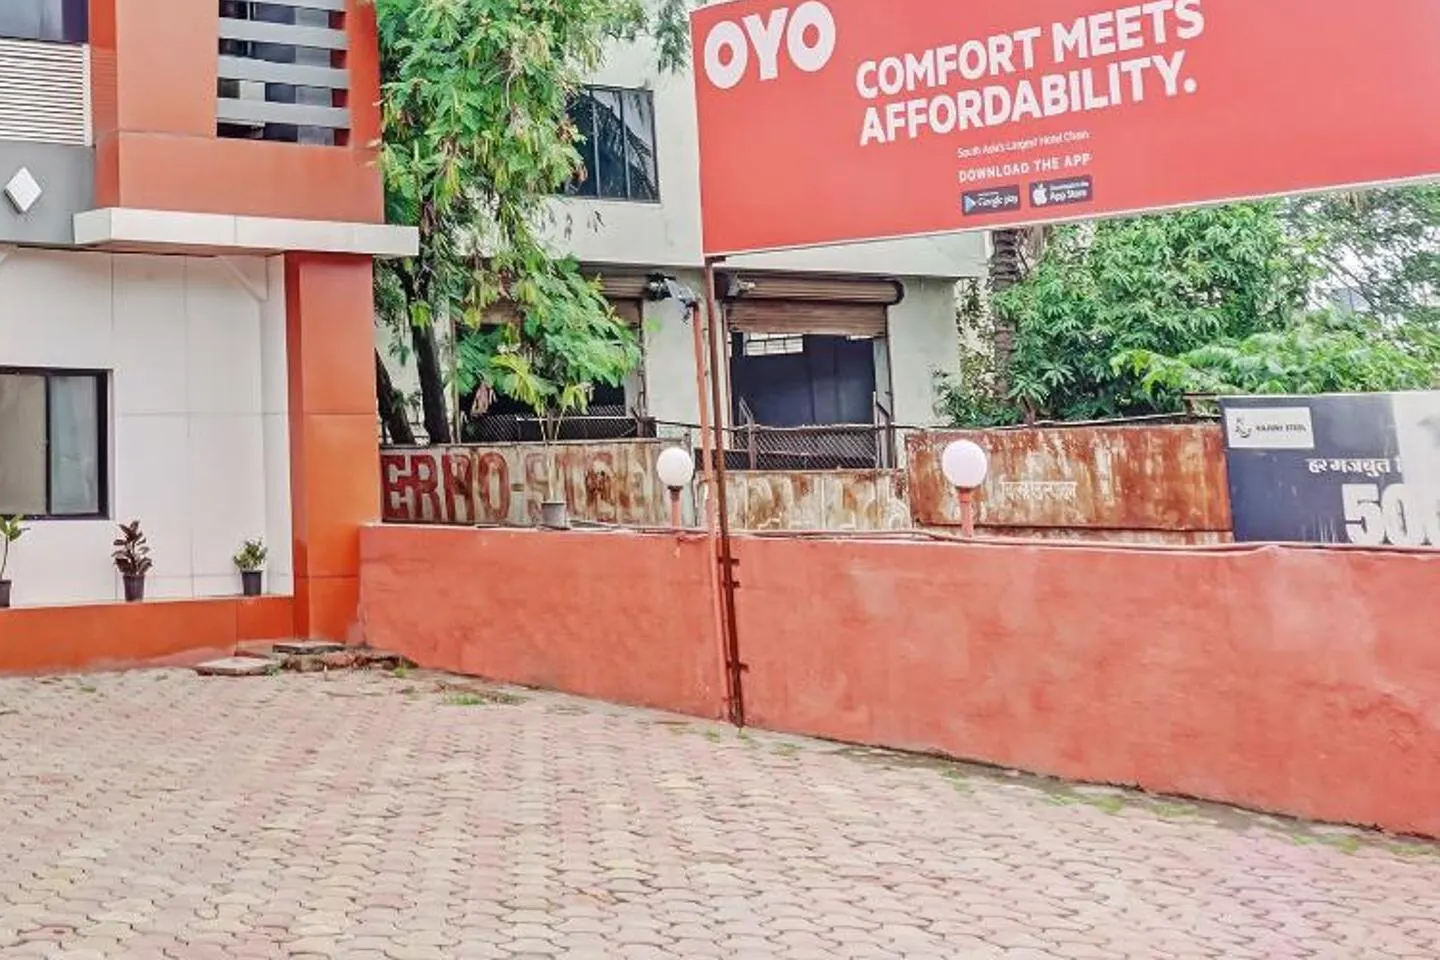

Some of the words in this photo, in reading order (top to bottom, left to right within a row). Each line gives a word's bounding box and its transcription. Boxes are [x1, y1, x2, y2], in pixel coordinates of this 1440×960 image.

[704, 0, 837, 90] OYO
[855, 26, 1042, 99] COMFORT
[860, 49, 1197, 146] AFFORDABILITY.
[959, 162, 1029, 182] DOWNLOAD
[1034, 157, 1060, 172] THE
[1064, 152, 1092, 167] APP
